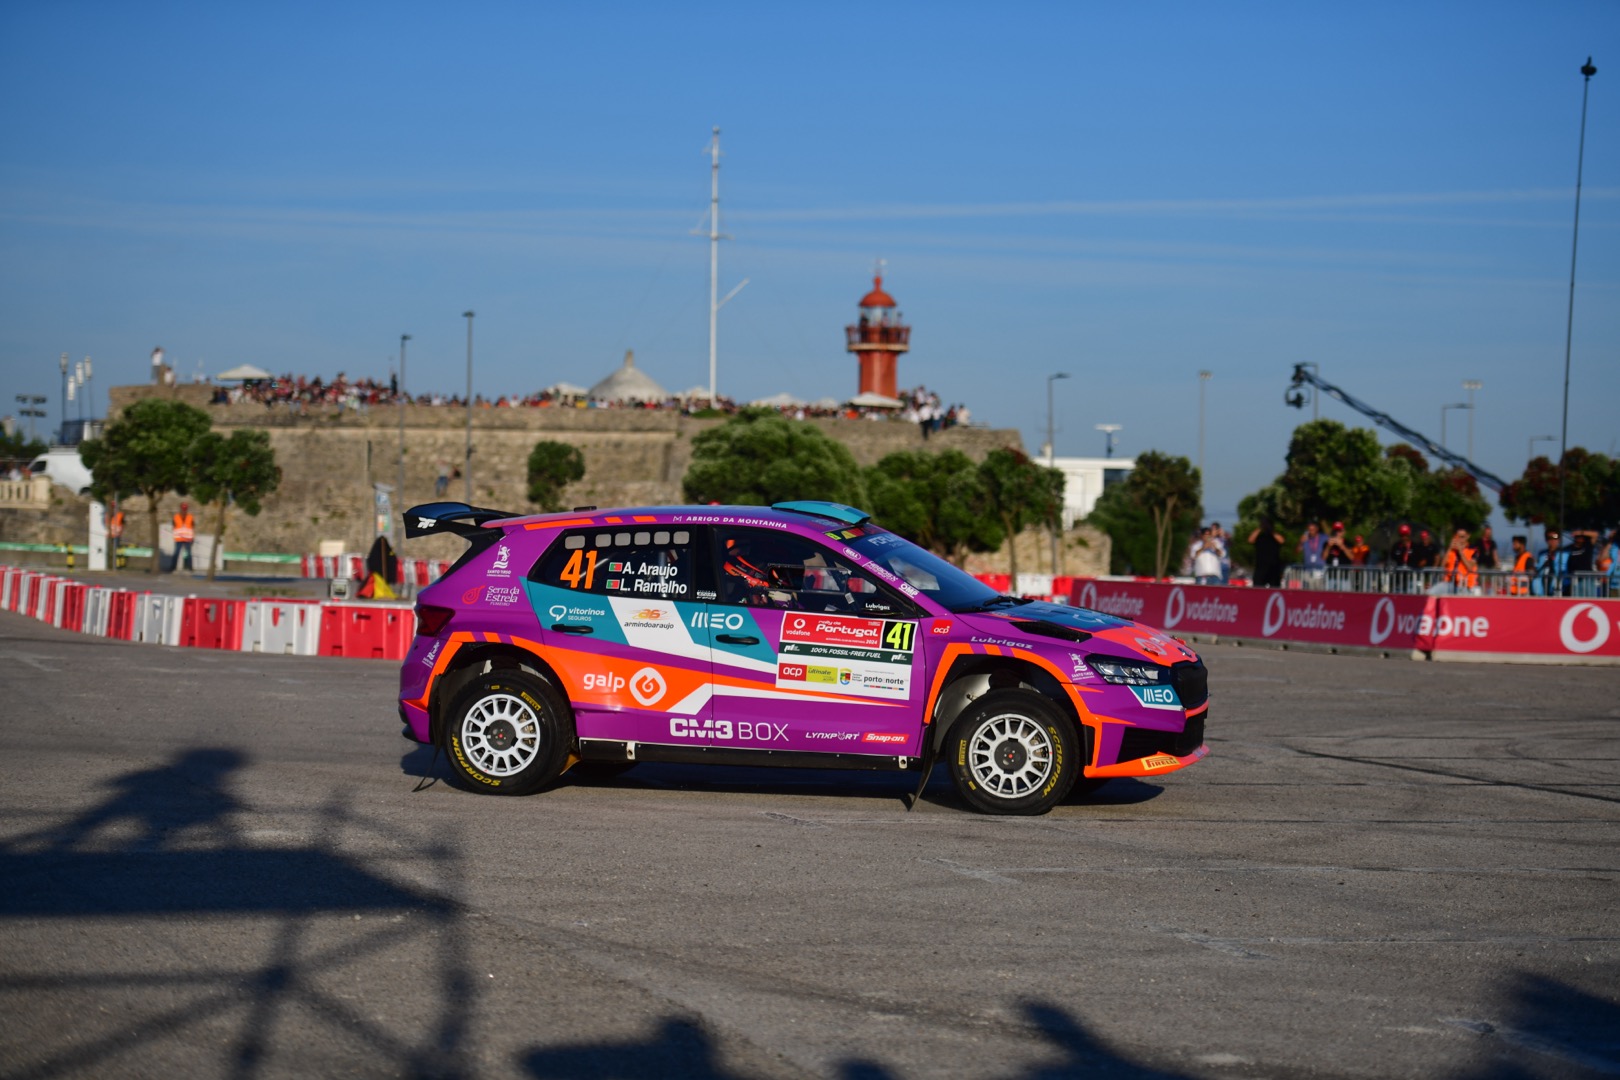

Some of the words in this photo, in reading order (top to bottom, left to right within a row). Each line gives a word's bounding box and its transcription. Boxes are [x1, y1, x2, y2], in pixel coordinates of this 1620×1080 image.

[737, 518, 788, 529] MONTANHA
[845, 548, 859, 559] BELL
[560, 549, 597, 589] 41
[622, 562, 635, 574] A.
[638, 563, 678, 577] Araujo
[487, 586, 509, 594] Serra
[509, 586, 520, 594] da
[620, 579, 631, 591] L.
[634, 579, 687, 594] Ramalho
[899, 582, 920, 597] OMP
[485, 593, 518, 603] Estrela
[1097, 592, 1144, 616] vodafone
[569, 608, 605, 616] vitorinos
[865, 602, 891, 610] Lubrigaz
[1186, 597, 1239, 623] vodafone
[691, 611, 744, 630] MEO
[1287, 602, 1345, 631] vodafone
[624, 621, 674, 630] armindoaraujo
[786, 629, 811, 637] vodafone
[816, 624, 878, 637] Portugal
[934, 625, 950, 634] acp
[886, 622, 912, 650] 41
[971, 636, 1034, 650] Lubrigaz
[828, 649, 866, 657] FOSSIL-FREE
[866, 651, 881, 659] FUEL
[783, 667, 803, 677] acp
[583, 672, 625, 692] galp
[522, 692, 541, 710] PIRELLI
[1143, 688, 1174, 703] MEO
[669, 718, 733, 740] CM3
[738, 722, 790, 742] BOX
[452, 736, 502, 787] SCORPION
[1043, 726, 1063, 797] SCORPION
[1145, 756, 1179, 769] PIRELLI
